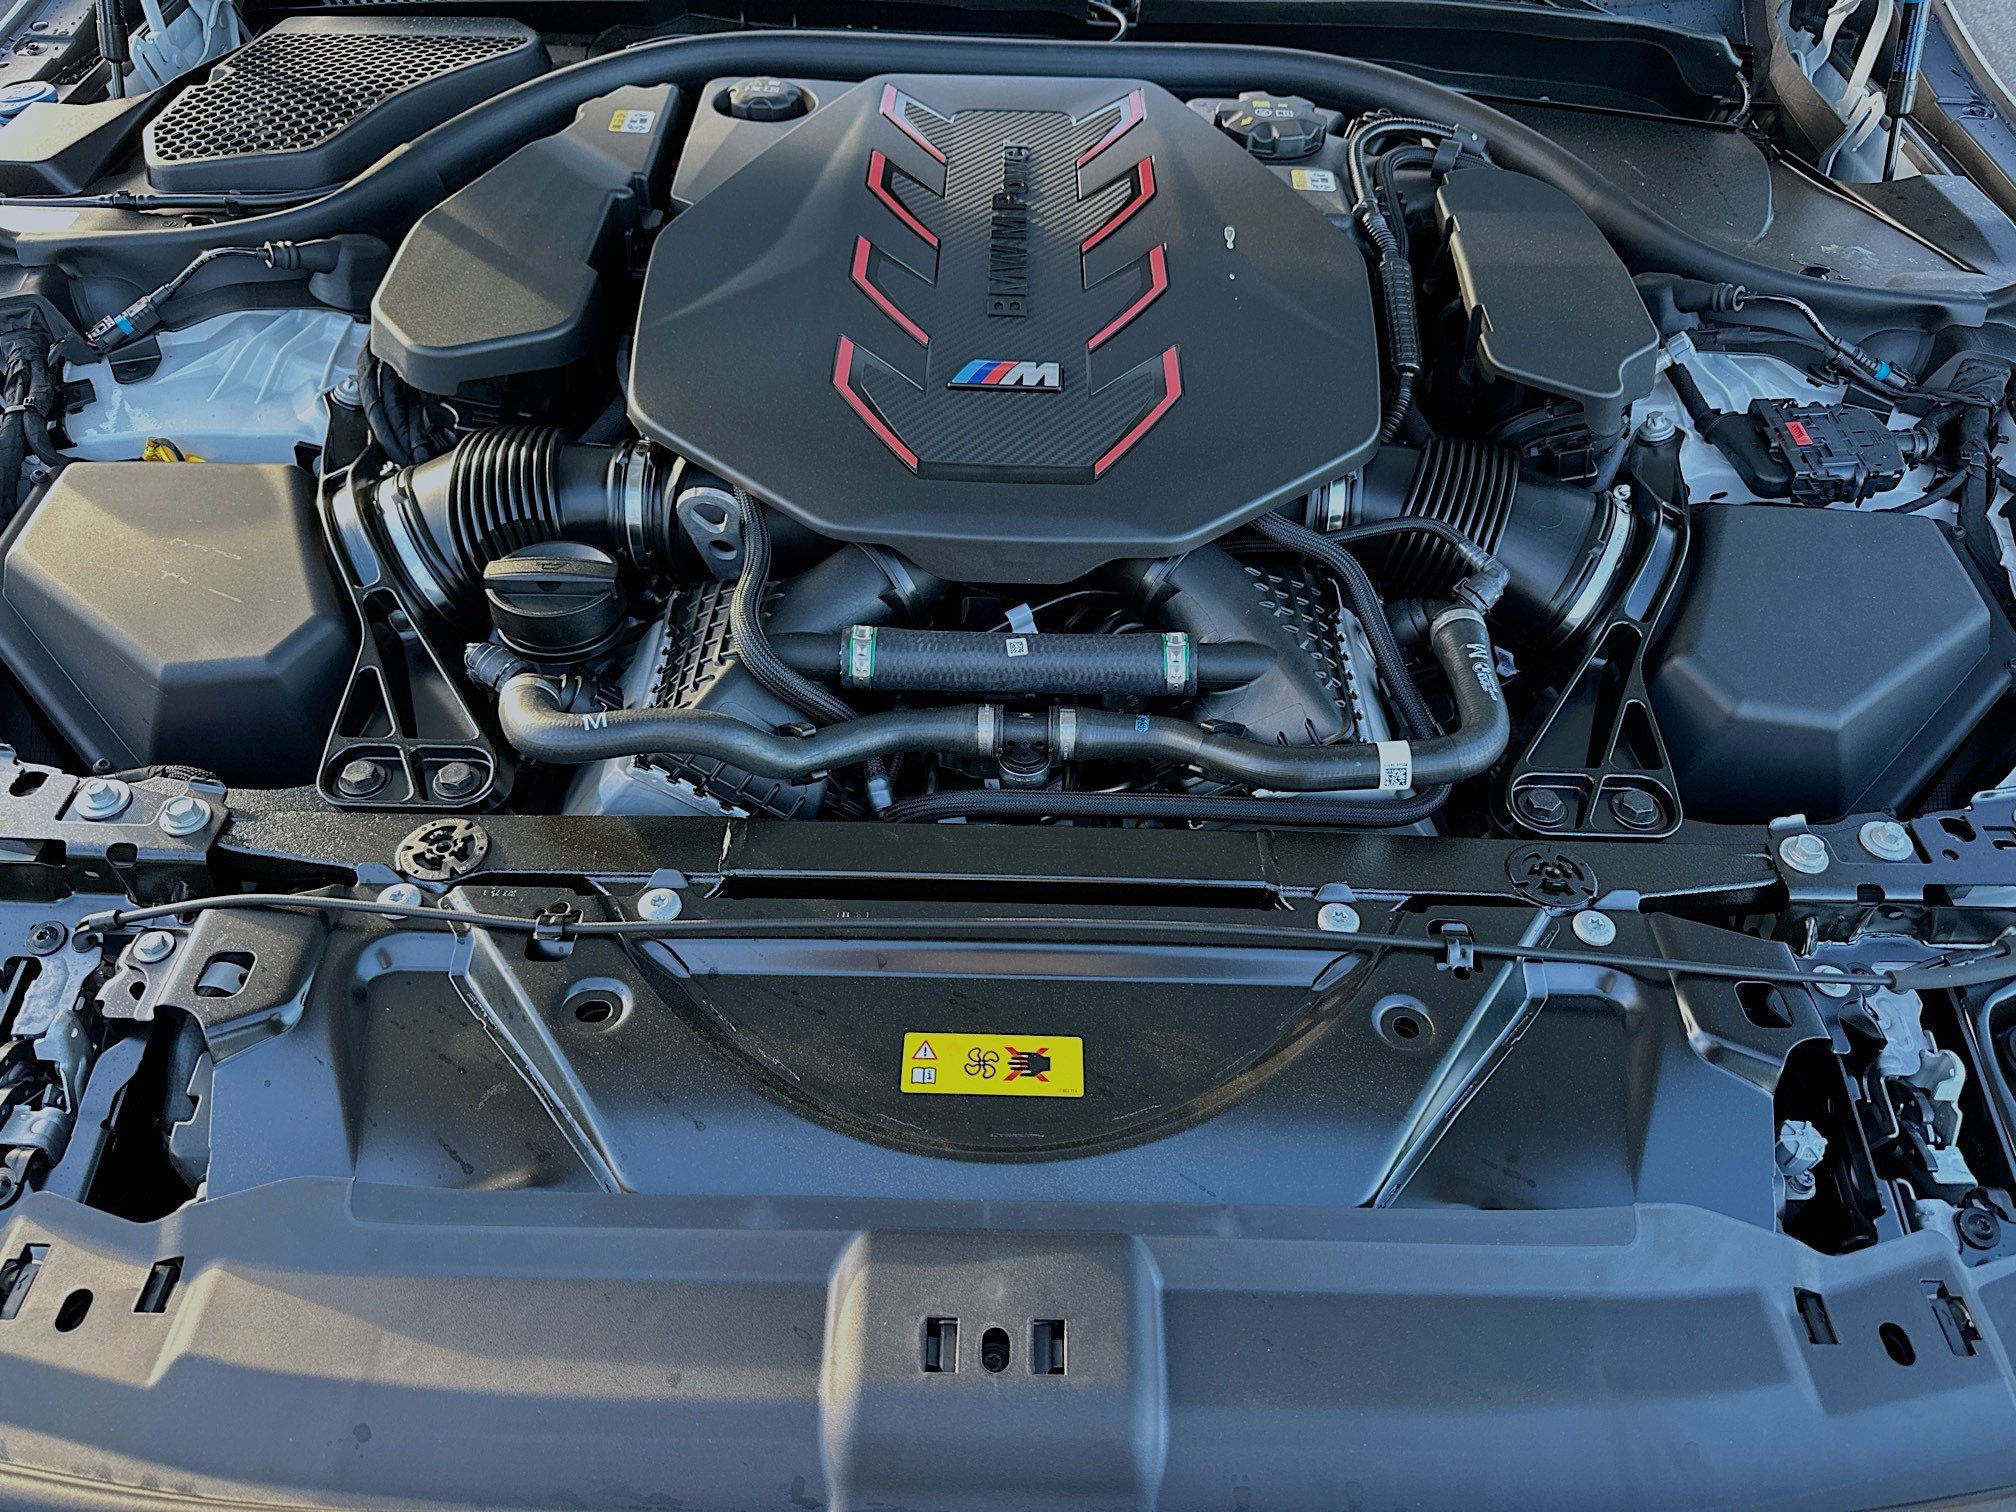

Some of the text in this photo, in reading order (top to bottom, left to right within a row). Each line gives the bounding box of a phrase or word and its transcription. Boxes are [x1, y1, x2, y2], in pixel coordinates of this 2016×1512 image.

[992, 139, 1030, 211] Power
[986, 244, 1028, 317] BMW
[582, 712, 607, 731] M
